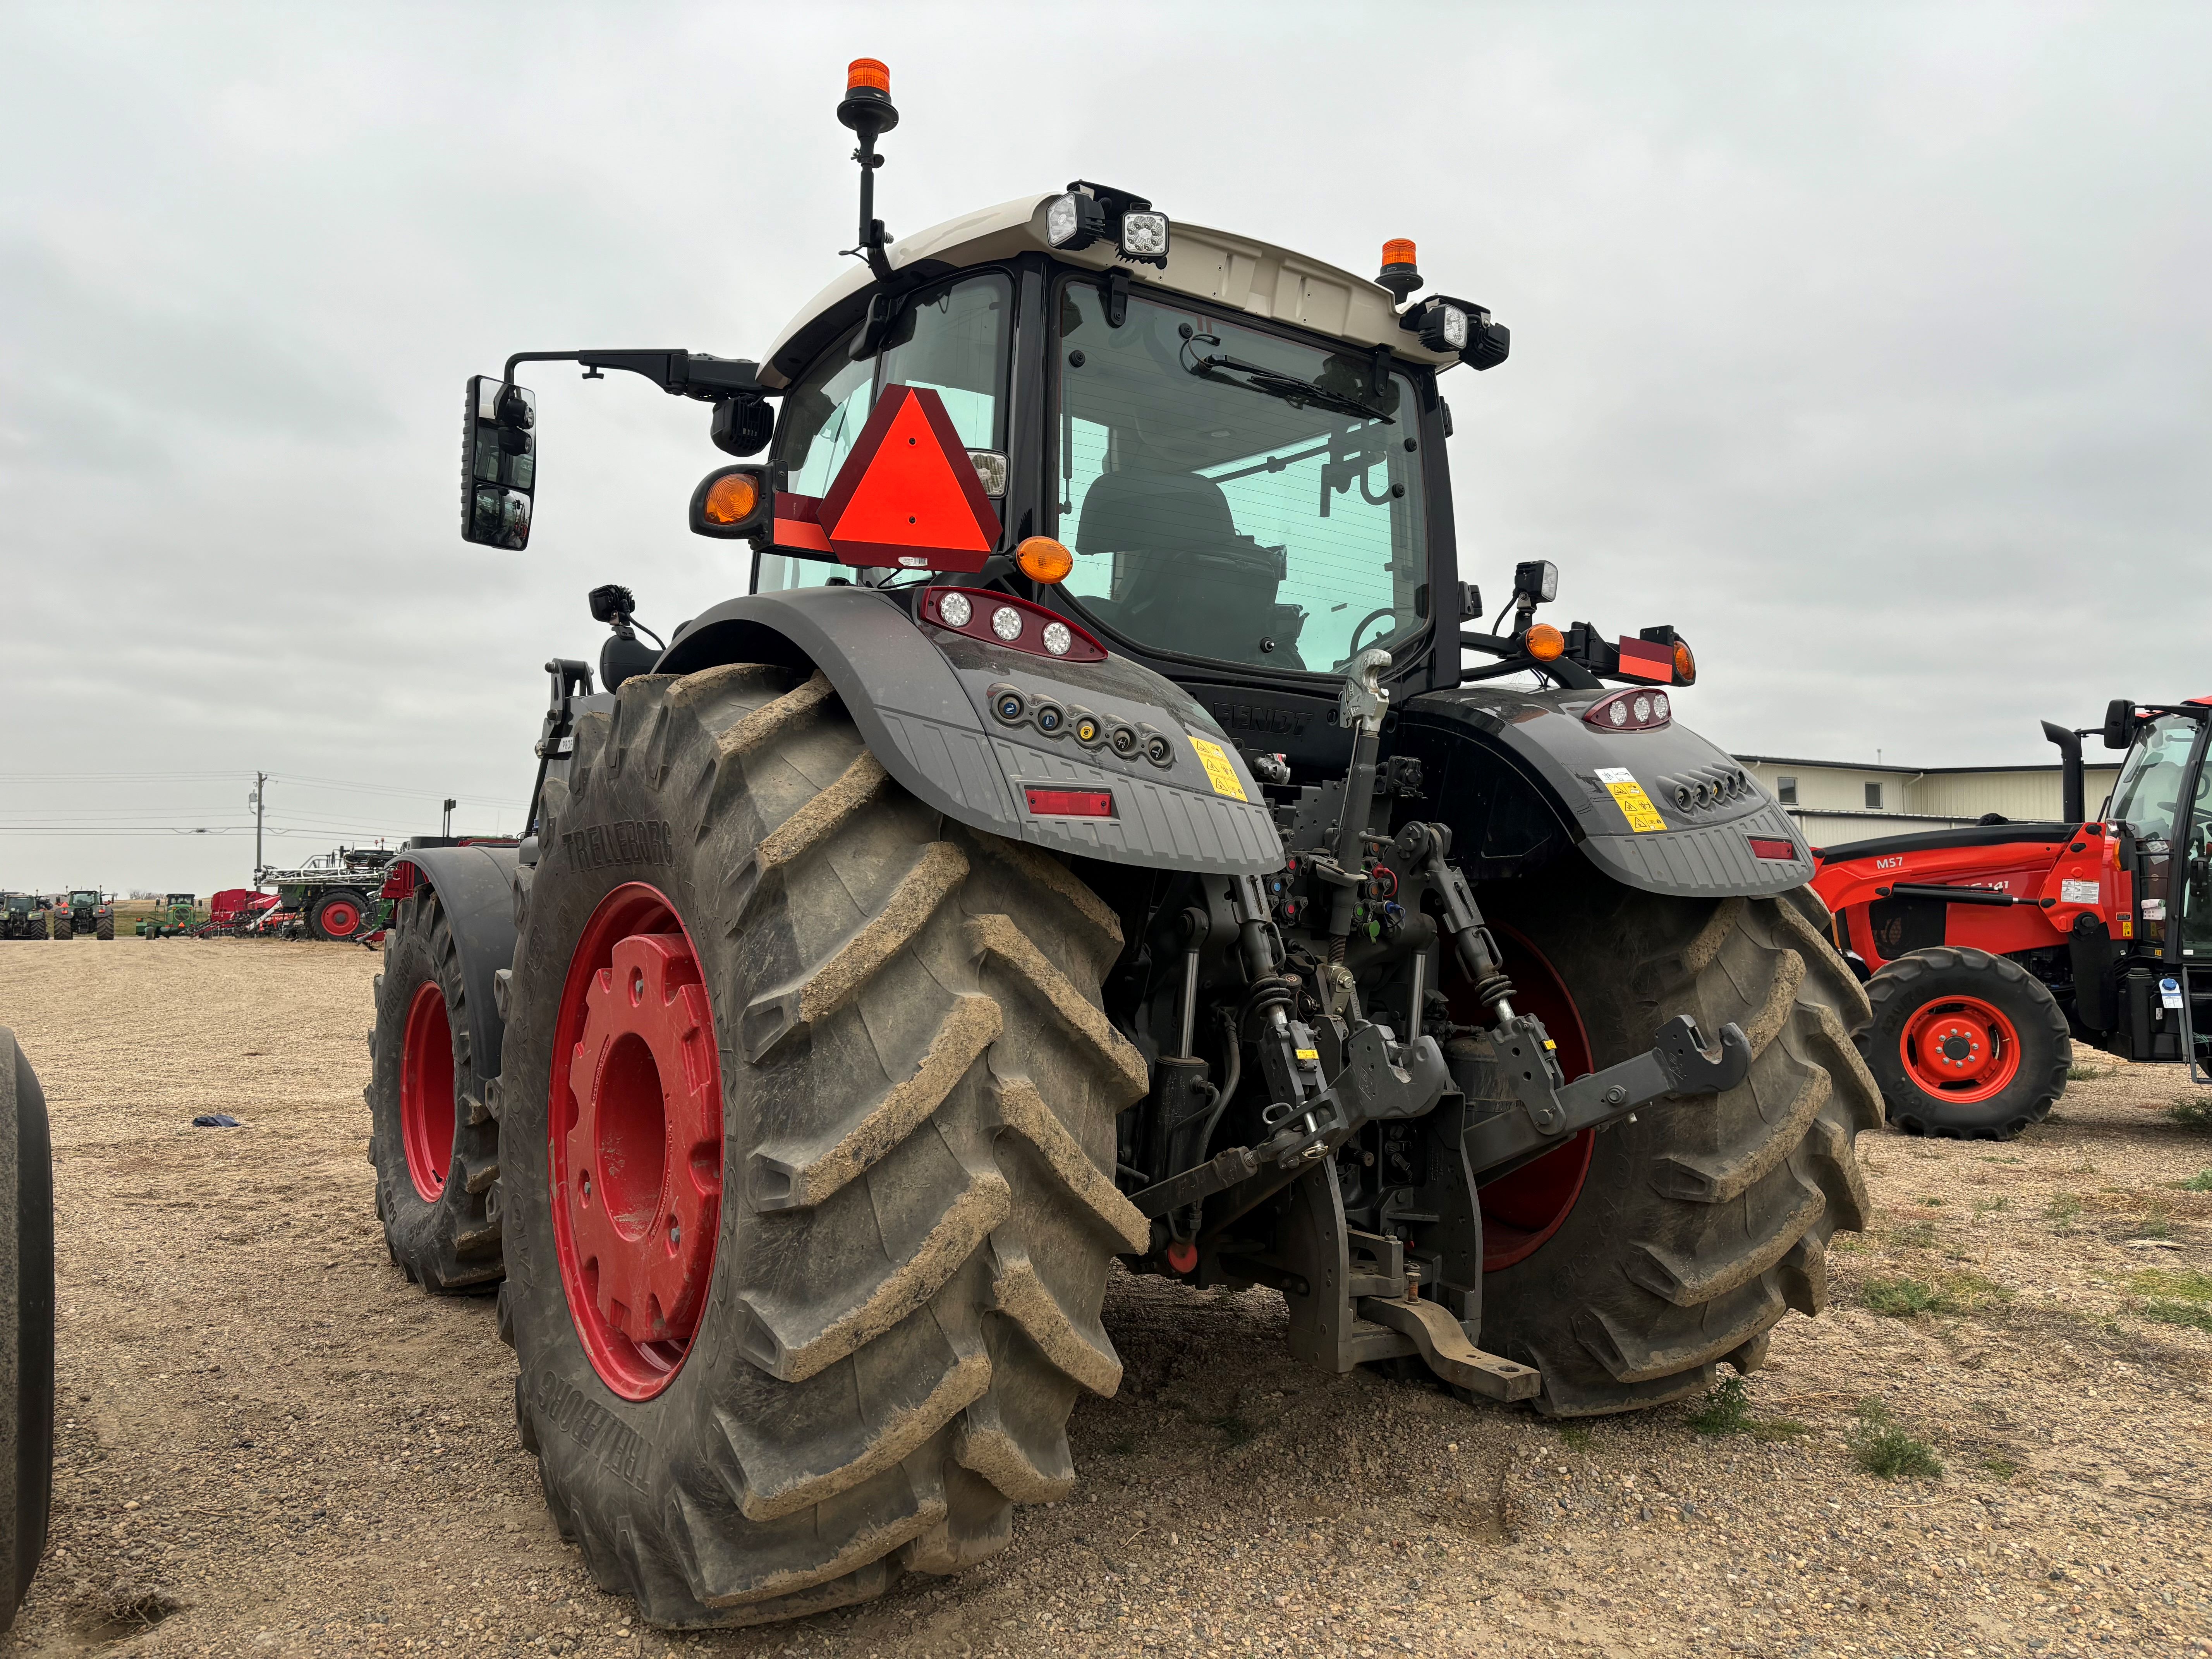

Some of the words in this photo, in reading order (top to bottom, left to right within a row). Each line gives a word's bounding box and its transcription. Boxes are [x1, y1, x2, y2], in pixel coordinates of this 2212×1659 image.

[1213, 702, 1314, 736] FENDT
[562, 820, 673, 873] TRELLEBORG
[1876, 857, 1903, 869] M57
[536, 1370, 653, 1497] TRELLEBORG
